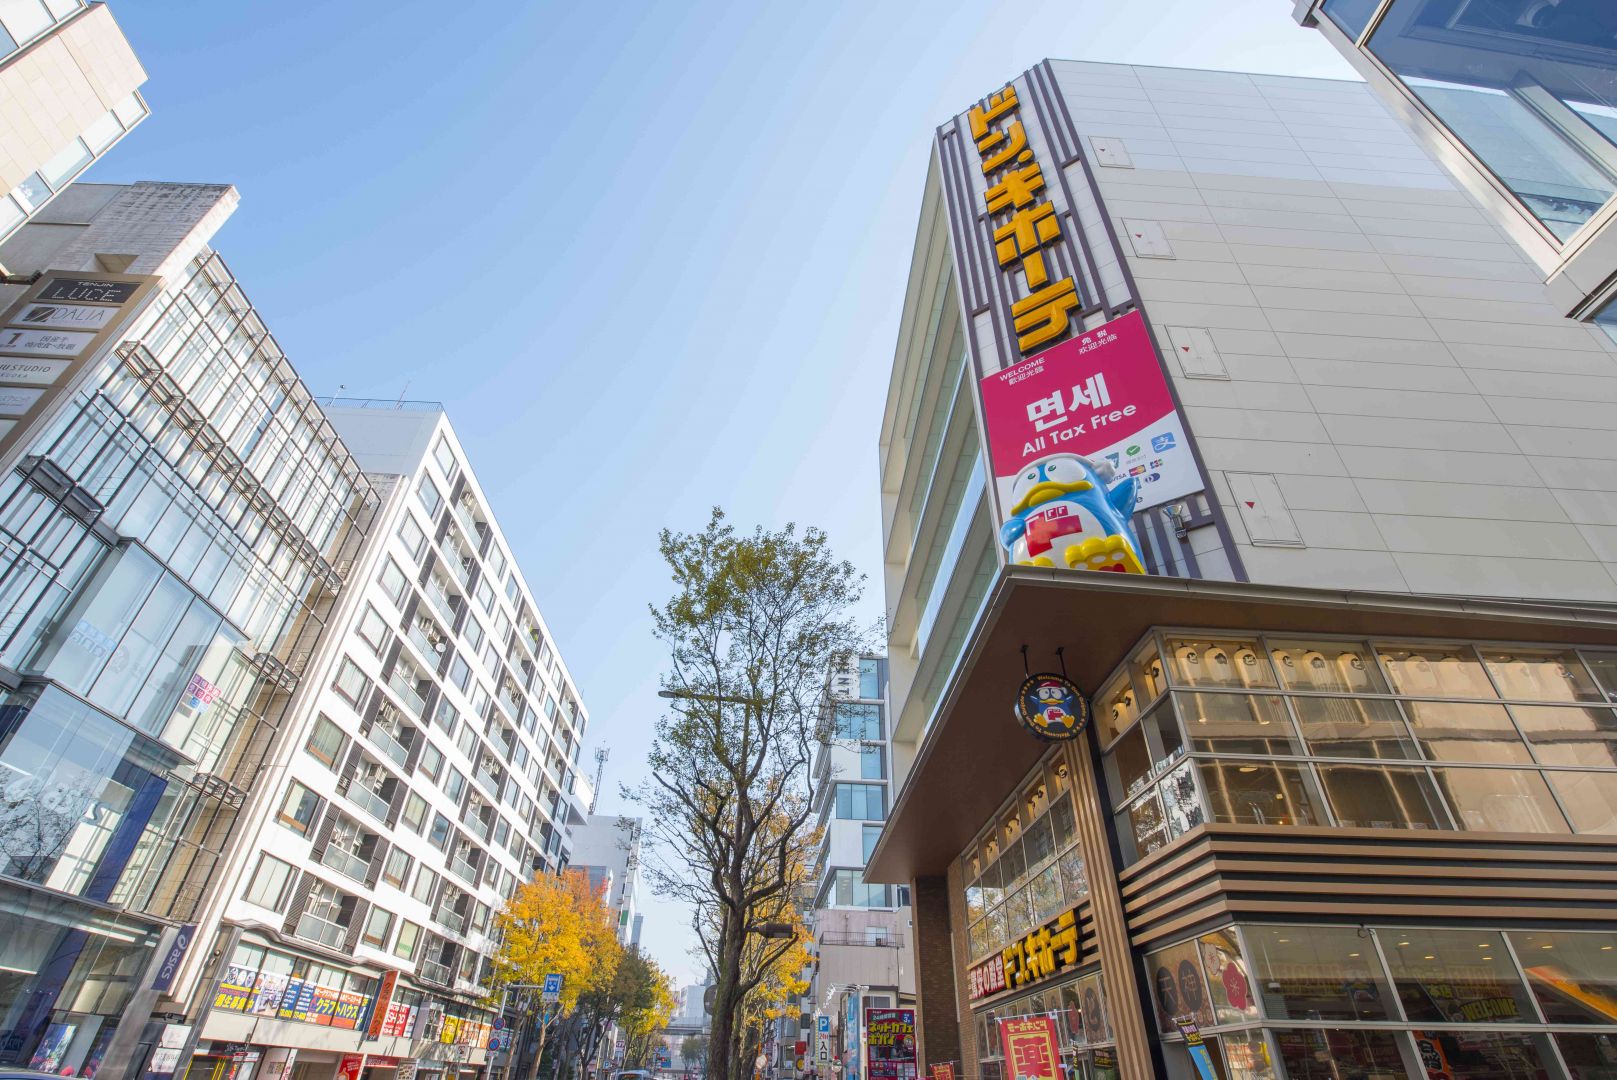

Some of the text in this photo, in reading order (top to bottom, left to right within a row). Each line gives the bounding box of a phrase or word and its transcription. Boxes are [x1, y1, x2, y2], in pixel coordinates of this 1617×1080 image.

[51, 286, 122, 302] LUCE
[12, 364, 52, 373] STUDIO
[999, 357, 1046, 382] WELCOME
[1026, 371, 1112, 433] 면세
[1022, 403, 1138, 457] All Tax Free
[161, 948, 181, 980] asics
[1158, 970, 1198, 1006] 天神
[316, 998, 359, 1019] クラフトハウス
[1460, 998, 1519, 1021] WELCOME
[820, 1018, 828, 1031] P
[869, 1022, 914, 1033] ネットカフェ
[868, 1033, 896, 1046] ポパイ
[820, 1041, 828, 1060] 入口
